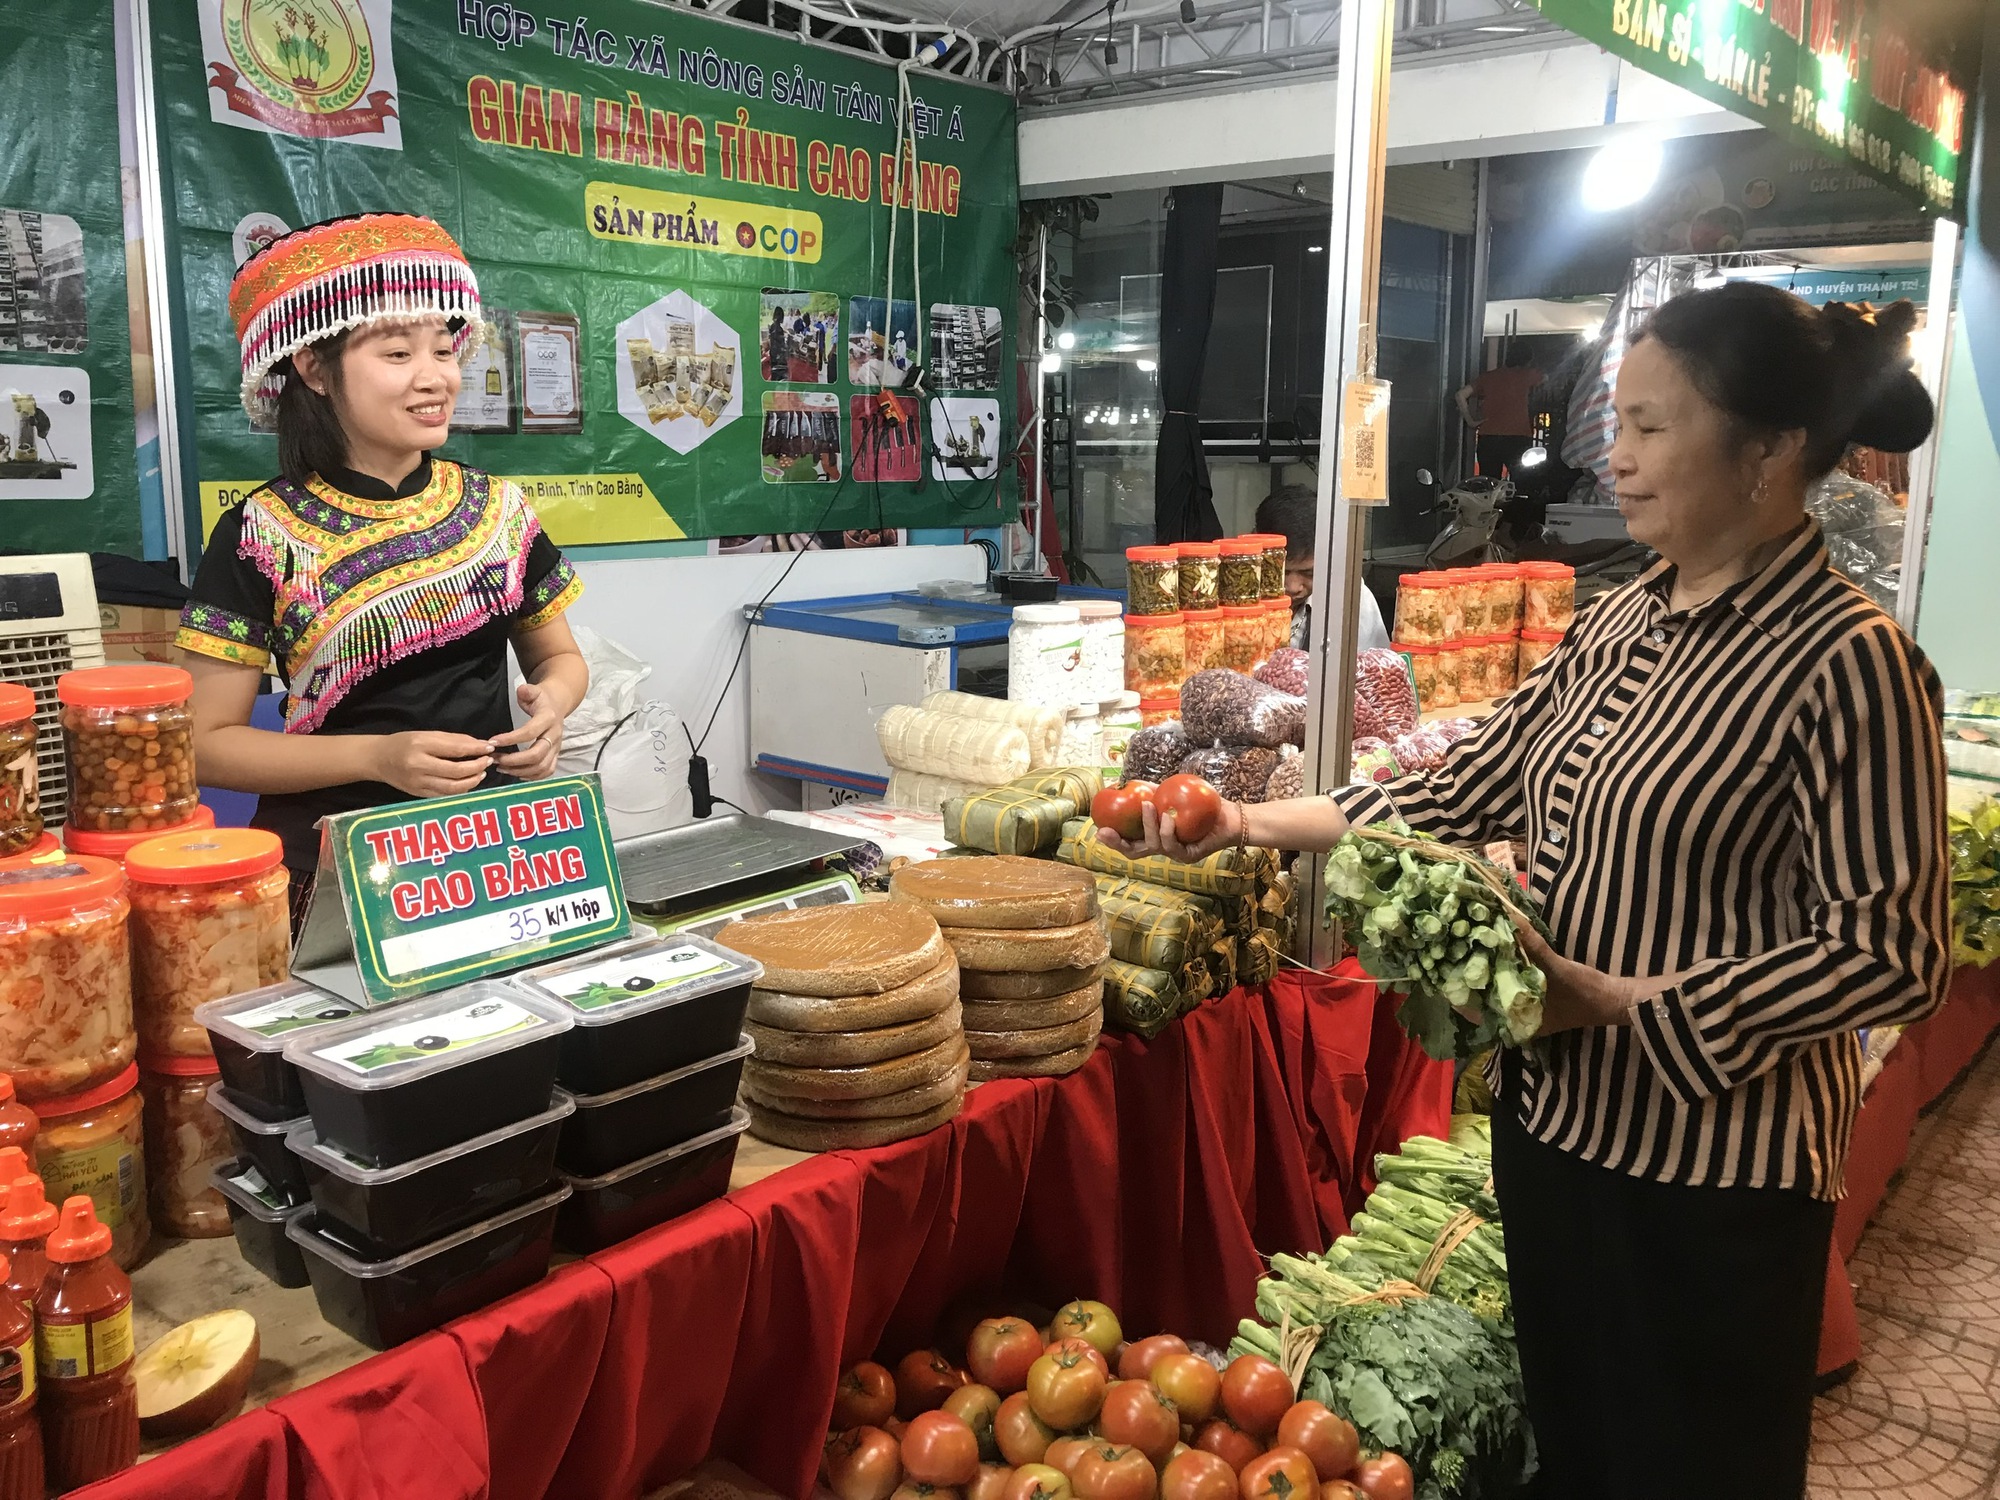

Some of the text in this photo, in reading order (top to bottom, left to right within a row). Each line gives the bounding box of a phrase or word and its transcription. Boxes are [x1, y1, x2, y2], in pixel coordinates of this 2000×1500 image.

[457, 0, 537, 51] HỢP
[545, 16, 618, 66] TÁC
[625, 34, 670, 79] XÃ
[678, 46, 763, 99] NÔNG
[771, 64, 826, 112] SẢN
[832, 81, 883, 125] TÂN
[947, 104, 965, 141] Á
[1747, 51, 1772, 108] LẺ
[467, 74, 960, 217] GIAN HÀNG TỈNH CAO BẰNG
[593, 195, 645, 237] SẢN
[652, 201, 719, 245] PHẨM
[1816, 281, 1854, 296] HUYỆN
[1857, 281, 1898, 293] THANH
[537, 481, 567, 498] Bình,
[568, 479, 594, 495] Tỉnh
[597, 481, 614, 496] Cao
[618, 478, 643, 498] Bằng
[365, 795, 585, 866] THẠCH ĐEN
[391, 846, 586, 922] CAO BẰNG
[508, 907, 542, 941] 35
[573, 898, 601, 922] hộp
